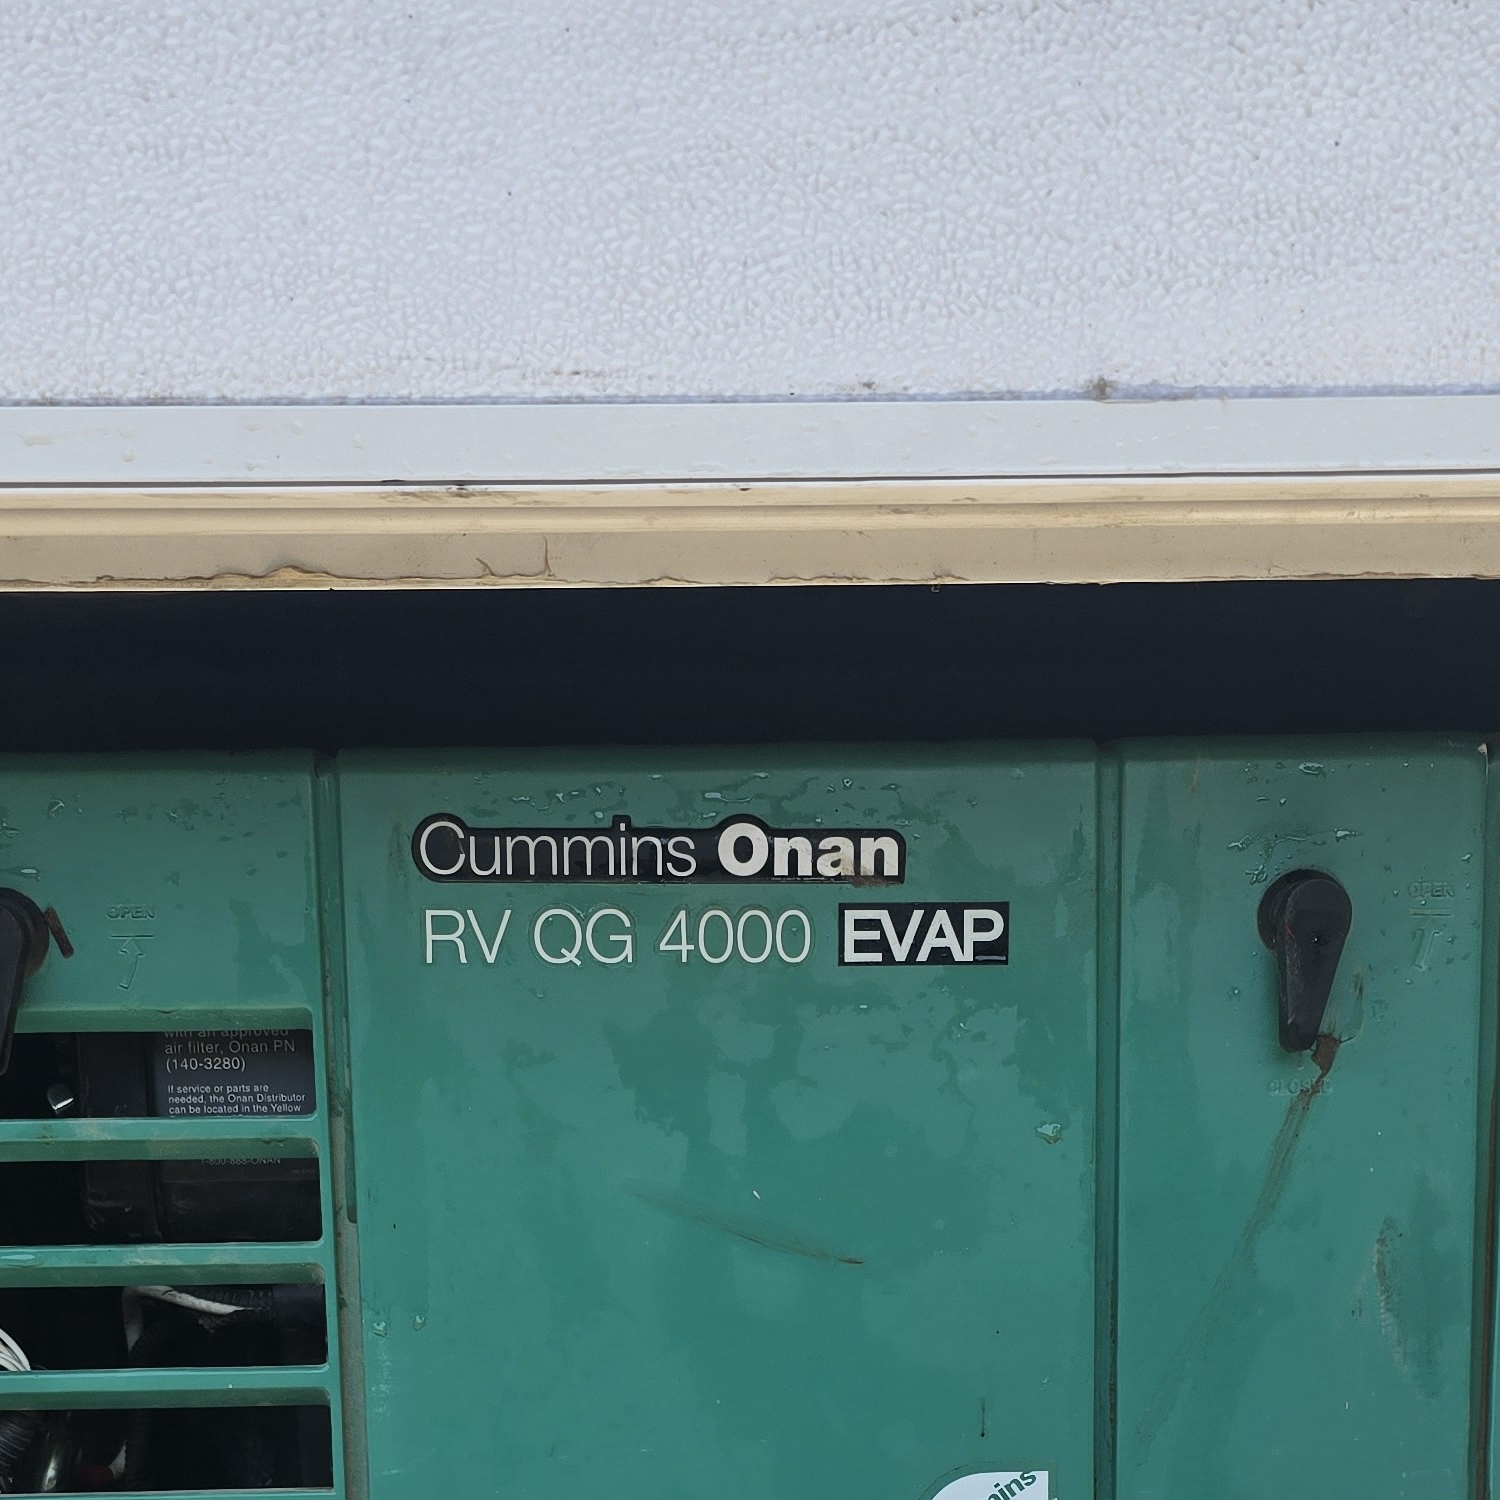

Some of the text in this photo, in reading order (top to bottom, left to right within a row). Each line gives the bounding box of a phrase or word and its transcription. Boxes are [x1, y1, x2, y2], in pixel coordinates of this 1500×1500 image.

[418, 820, 902, 878] Cummins Onan
[1406, 881, 1456, 898] OPEN
[106, 905, 156, 920] OPEN
[425, 907, 1006, 967] RV QG 4000 EVAP
[164, 1039, 296, 1056] air filter, Onan PN
[166, 1056, 247, 1074] (140-3280)
[176, 1084, 211, 1094] service
[213, 1085, 224, 1093] or
[226, 1084, 251, 1095] parts
[253, 1084, 270, 1093] are
[168, 1092, 306, 1105] needed, the Onan Distributor
[168, 1103, 302, 1115] can be located in the Yellow
